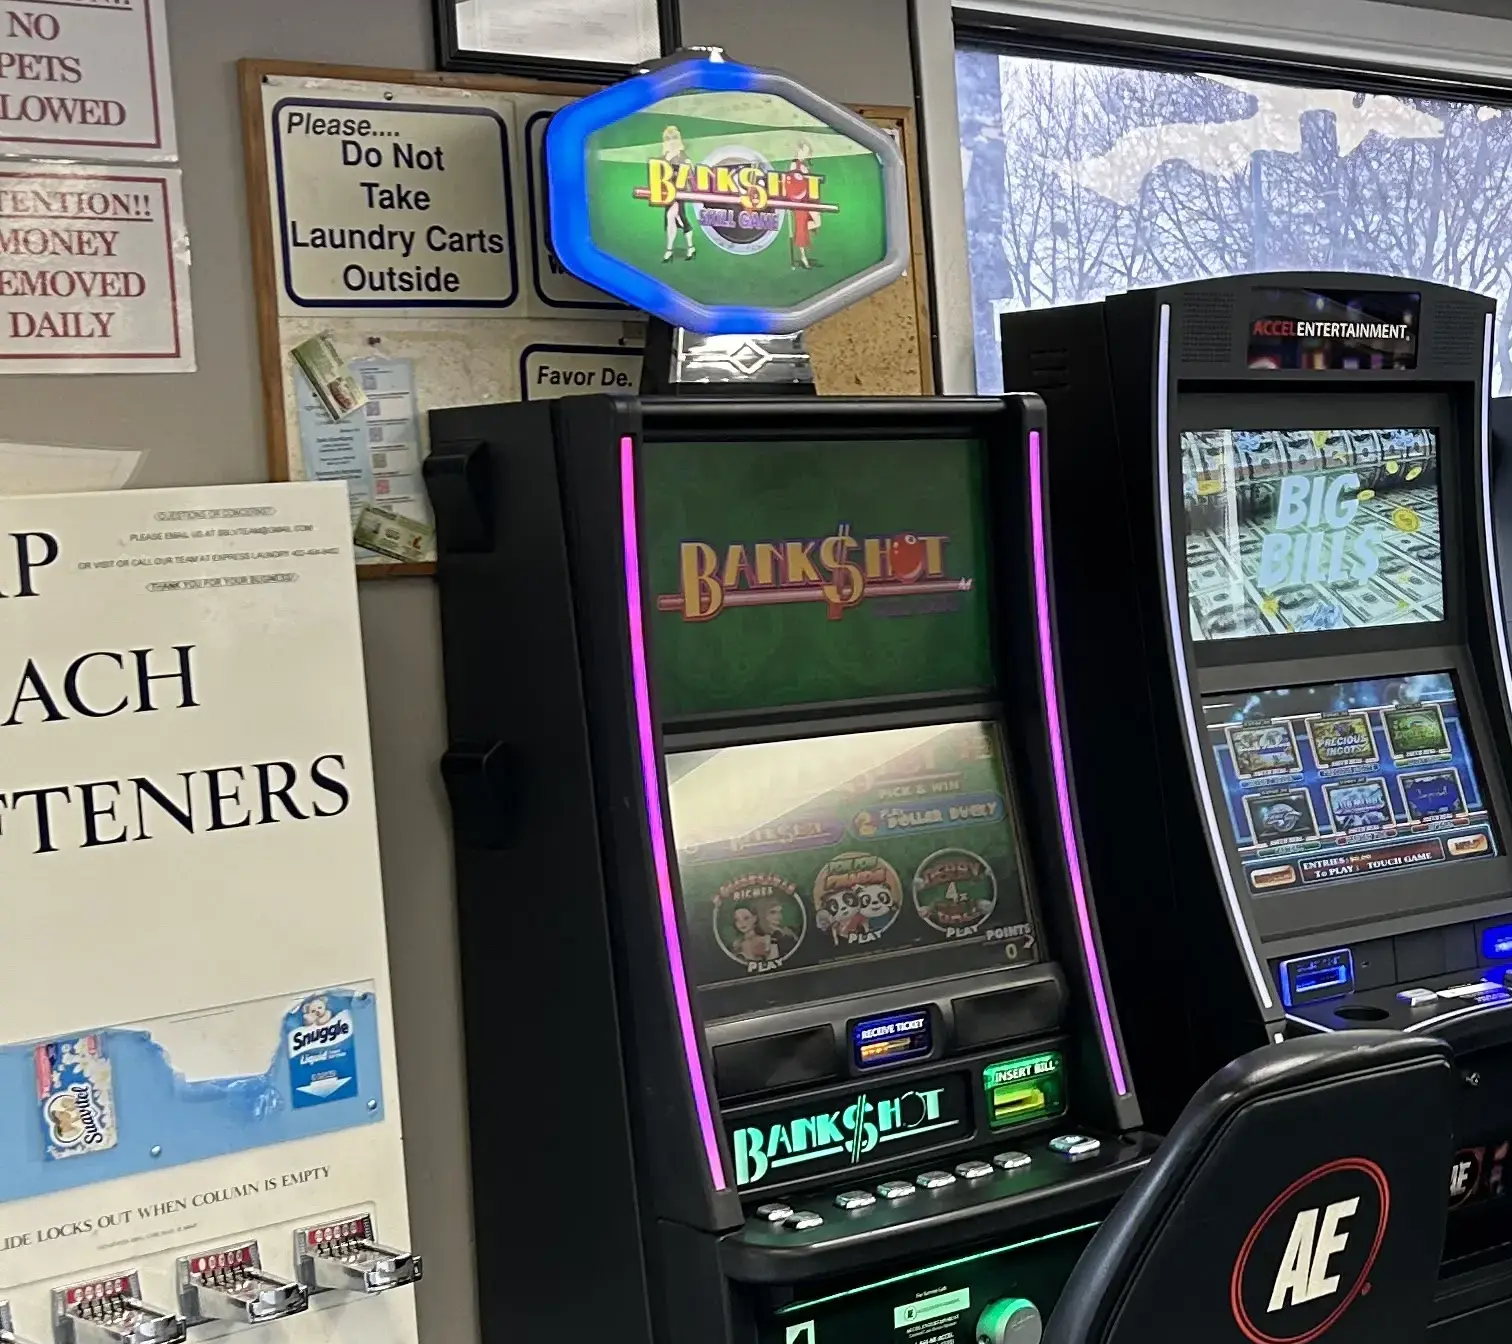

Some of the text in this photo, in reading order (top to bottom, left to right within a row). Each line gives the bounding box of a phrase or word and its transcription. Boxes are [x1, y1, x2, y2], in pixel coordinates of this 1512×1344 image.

[7, 11, 60, 41] NO
[0, 52, 82, 83] PETS
[287, 112, 400, 137] Please....
[341, 140, 445, 171] Do Not
[360, 182, 431, 210] Take
[738, 209, 780, 232] GAME
[0, 228, 119, 256] MONEY
[291, 221, 504, 258] Laundry Carts
[343, 264, 460, 293] Outside
[8, 311, 115, 338] DAILY
[537, 366, 633, 387] Favor De.
[1276, 473, 1360, 530] BIG
[1258, 525, 1383, 588] BILL$
[1320, 735, 1368, 748] PRECIOUS
[1367, 857, 1402, 870] TOUCH
[1404, 851, 1432, 864] GAME
[985, 923, 1032, 941] POINTS
[748, 924, 979, 973] PLAY PLAY PLAY
[1005, 943, 1017, 959] 0
[293, 1019, 349, 1050] Snuggle
[861, 1018, 924, 1039] RECEIVE TICKET
[995, 1060, 1055, 1082] INSERT BILL
[71, 1086, 103, 1144] Suavitel
[37, 1219, 93, 1243] LOCKS
[97, 1210, 133, 1229] OUT
[138, 1198, 187, 1220] WHEN
[192, 1182, 259, 1207] COLUMN
[264, 1178, 277, 1192] IS
[282, 1165, 331, 1188] EMPTY
[1267, 1196, 1360, 1312] AE
